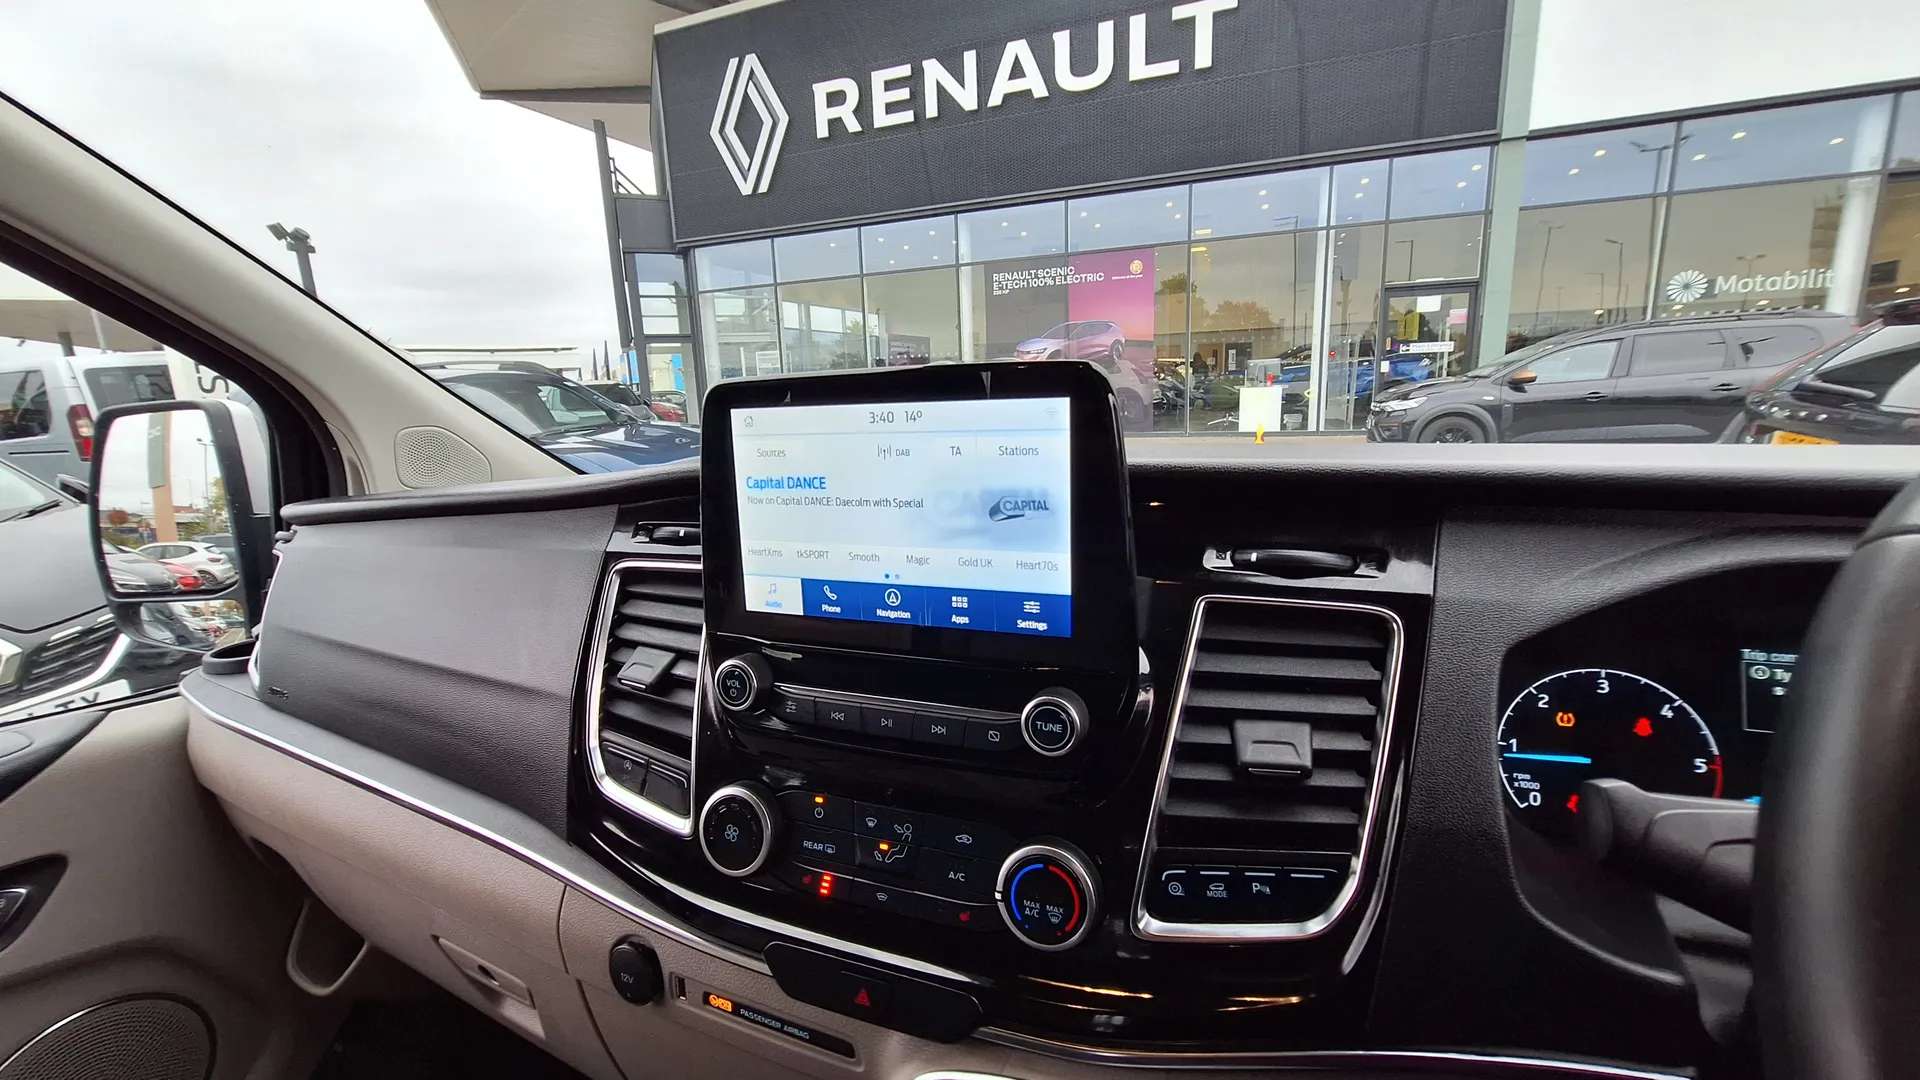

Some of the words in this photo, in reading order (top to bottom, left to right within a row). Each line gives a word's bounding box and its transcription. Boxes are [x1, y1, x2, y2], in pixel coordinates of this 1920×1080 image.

[812, 0, 1238, 139] RENAULT
[993, 269, 1038, 282] RENAULT
[1038, 266, 1075, 278] SCENIC
[993, 278, 1027, 291] E-TECH
[1029, 276, 1054, 288] 100%
[1056, 272, 1104, 286] ELECTRIC
[1714, 268, 1835, 294] Motabilit
[869, 411, 894, 424] 3:40
[756, 448, 786, 458] Sources
[950, 446, 962, 456] TA
[998, 445, 1039, 456] Stations
[746, 476, 784, 490] Capital
[787, 476, 826, 489] DANCE
[748, 496, 764, 505] Now
[764, 497, 775, 505] on
[776, 496, 803, 507] Capital
[804, 497, 834, 507] DANCE:
[835, 497, 871, 507] Daecolm
[873, 497, 891, 508] with
[893, 498, 924, 510] Special
[1002, 499, 1049, 511] CAPITAL
[848, 551, 880, 562] Smooth
[906, 554, 931, 566] Magic
[958, 557, 978, 568] Gold
[981, 558, 993, 568] UK
[1016, 560, 1058, 572] Heart70s
[821, 604, 841, 614] Phone
[876, 608, 911, 619] Navigation
[951, 614, 970, 624] Apps
[1016, 620, 1048, 631] Settings
[726, 679, 741, 688] VOL
[1596, 680, 1610, 693] 3
[1537, 694, 1549, 708] 2
[1660, 704, 1673, 718] 4
[1036, 721, 1063, 733] TUNE
[1508, 738, 1518, 752] 1
[1693, 759, 1708, 774] 5
[1513, 781, 1541, 790] x1000
[1529, 791, 1541, 806] 0
[803, 841, 823, 851] REAR
[948, 871, 966, 882] A/C
[1206, 890, 1228, 898] MODE
[1023, 899, 1041, 909] MAX
[1045, 904, 1064, 914] MAX
[1024, 908, 1039, 918] A/C
[620, 972, 634, 984] 12V
[740, 1008, 782, 1029] PASSENGER
[783, 1024, 810, 1040] AIRBAG
